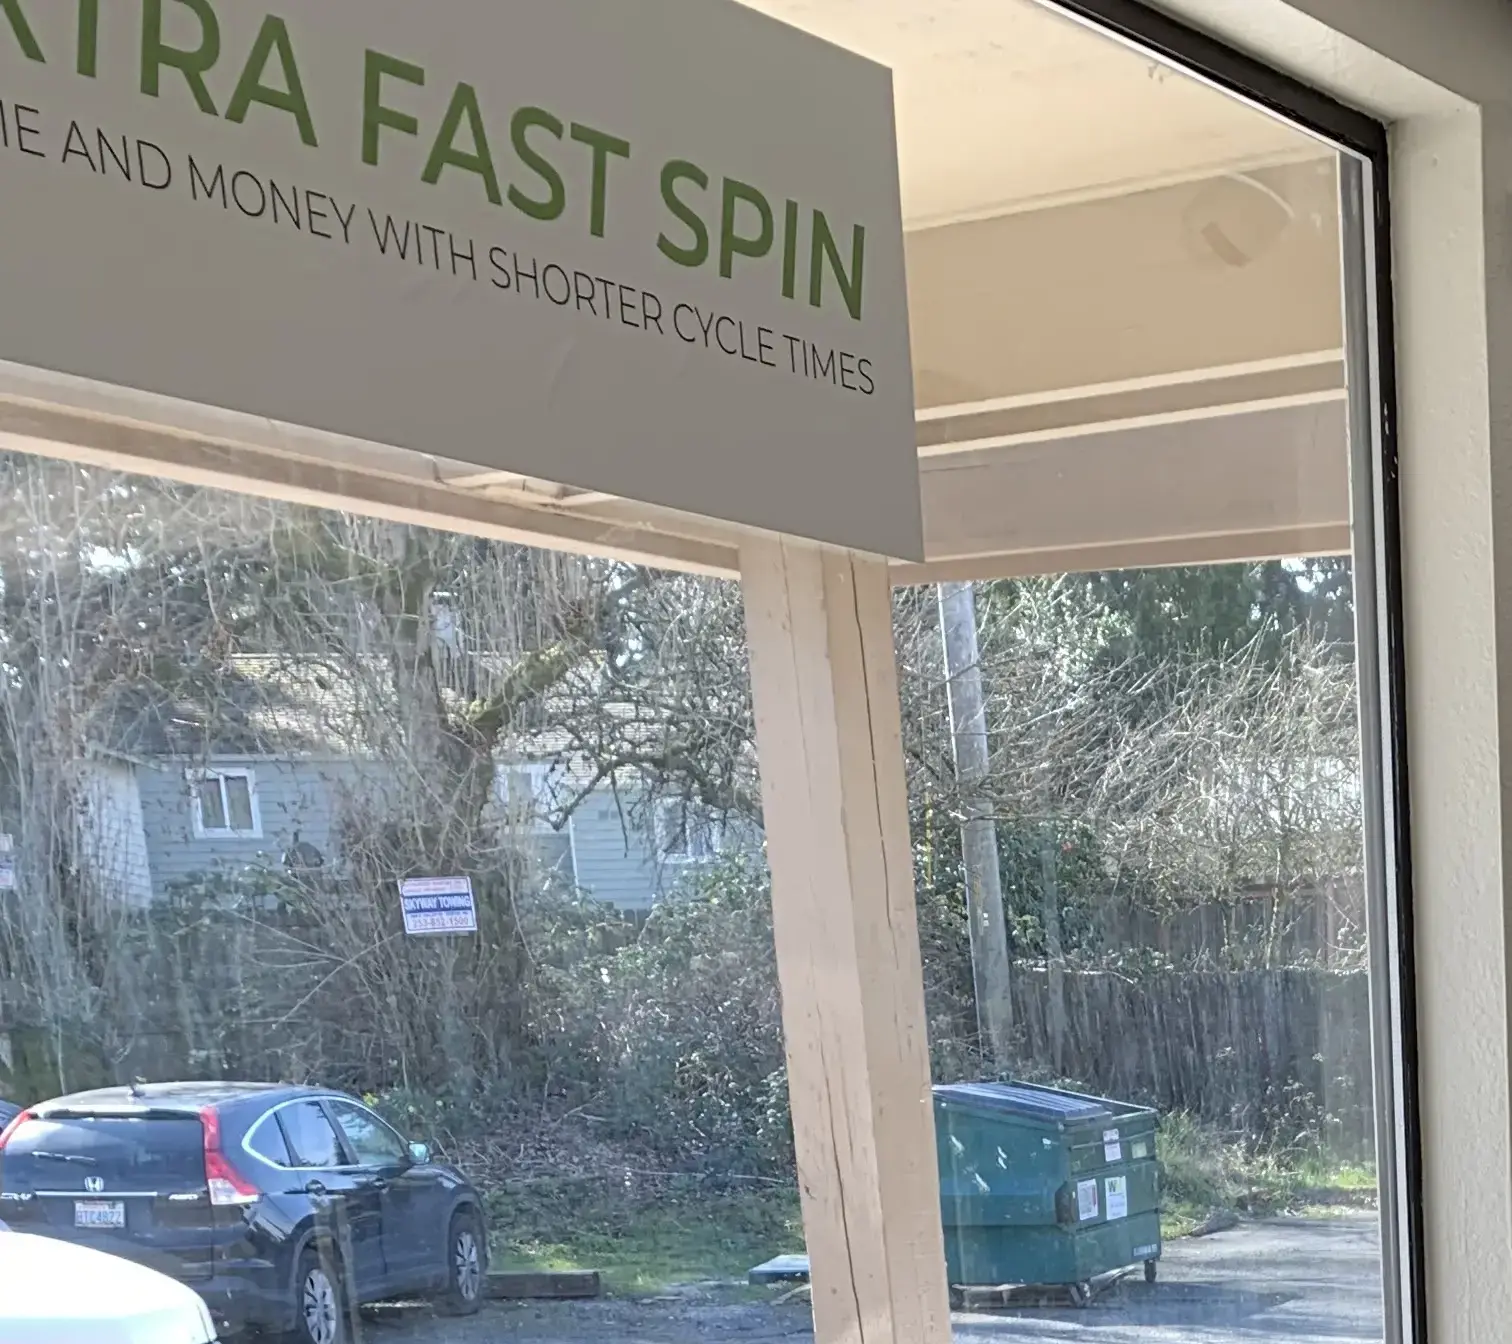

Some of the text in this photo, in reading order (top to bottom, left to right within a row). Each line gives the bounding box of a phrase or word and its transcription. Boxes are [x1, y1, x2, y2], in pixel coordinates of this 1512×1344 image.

[0, 0, 864, 321] RA FAST SPIN
[0, 102, 875, 395] E AND MONEY WITH SHORTER CYCLE TIMES
[404, 895, 471, 911] SKYWAY TOWING
